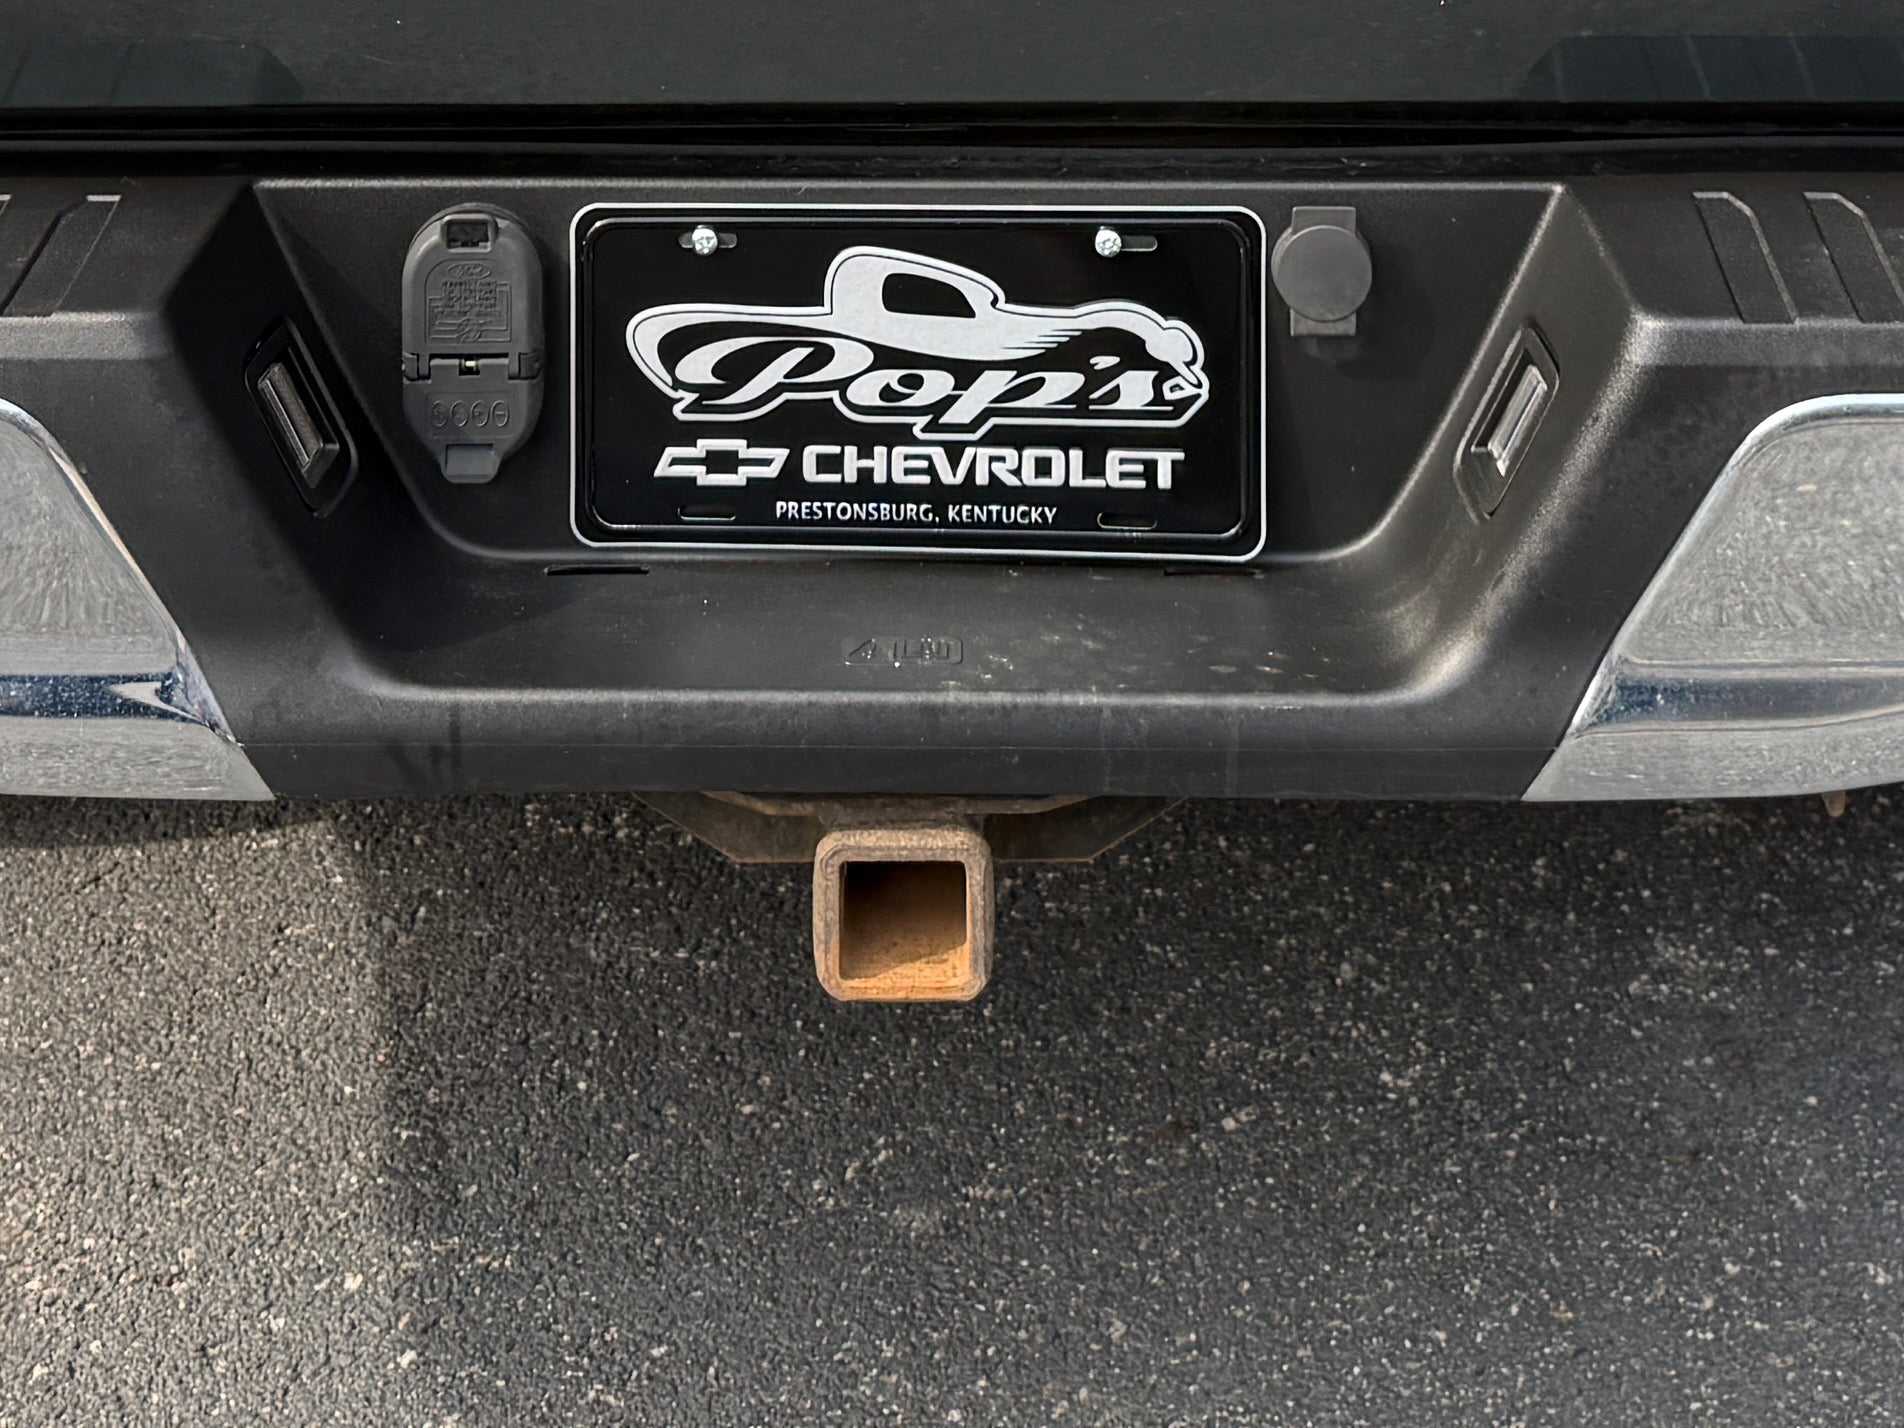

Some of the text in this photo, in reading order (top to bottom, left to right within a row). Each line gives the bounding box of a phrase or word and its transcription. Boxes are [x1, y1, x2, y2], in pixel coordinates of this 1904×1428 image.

[672, 335, 1173, 427] Pop's
[801, 444, 1185, 491] CHEVROLET
[774, 500, 1058, 526] PRESTONSBURG, KENTUCKY
